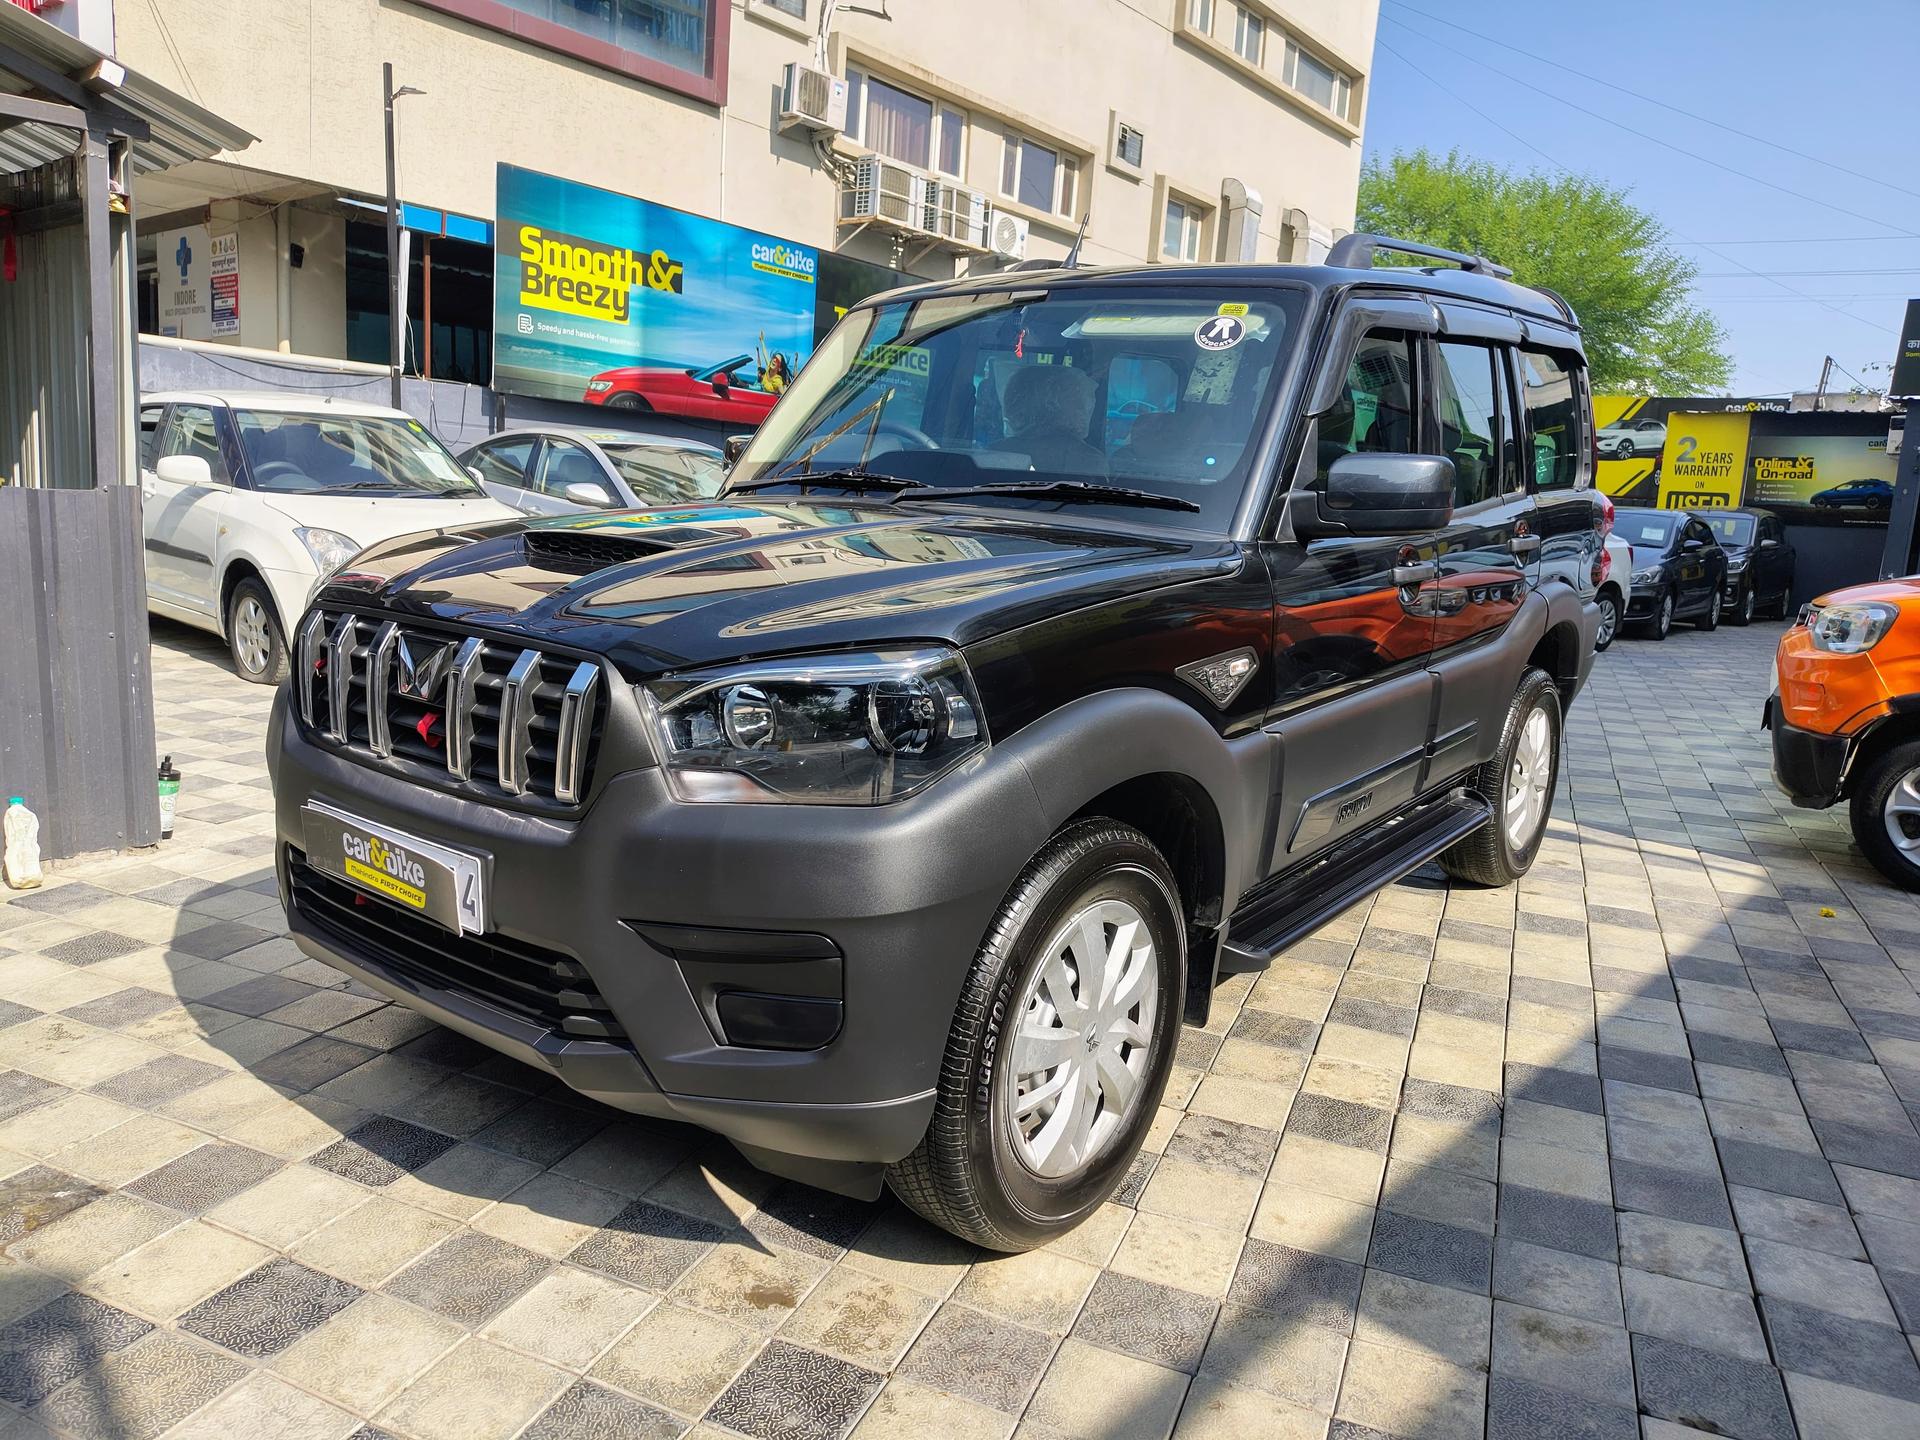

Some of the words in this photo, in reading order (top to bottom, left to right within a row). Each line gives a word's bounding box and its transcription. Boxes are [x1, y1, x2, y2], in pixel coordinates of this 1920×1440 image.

[519, 226, 642, 287] Smooth
[646, 249, 683, 294] &
[751, 243, 815, 273] car&bike
[174, 289, 197, 306] INDORE
[521, 260, 630, 321] Breezy
[537, 322, 562, 336] Speedy
[562, 327, 575, 336] and
[1675, 436, 1698, 462] 2
[1700, 452, 1734, 464] YEARS
[1674, 465, 1732, 477] WARRANTY
[1754, 456, 1793, 468] Online
[1795, 455, 1814, 469] &
[1761, 468, 1814, 479] On-road
[1695, 481, 1705, 489] ON
[342, 832, 426, 888] car&bike
[351, 864, 379, 883] Mahindra
[380, 878, 398, 892] FIRST
[399, 887, 423, 903] CHOICE
